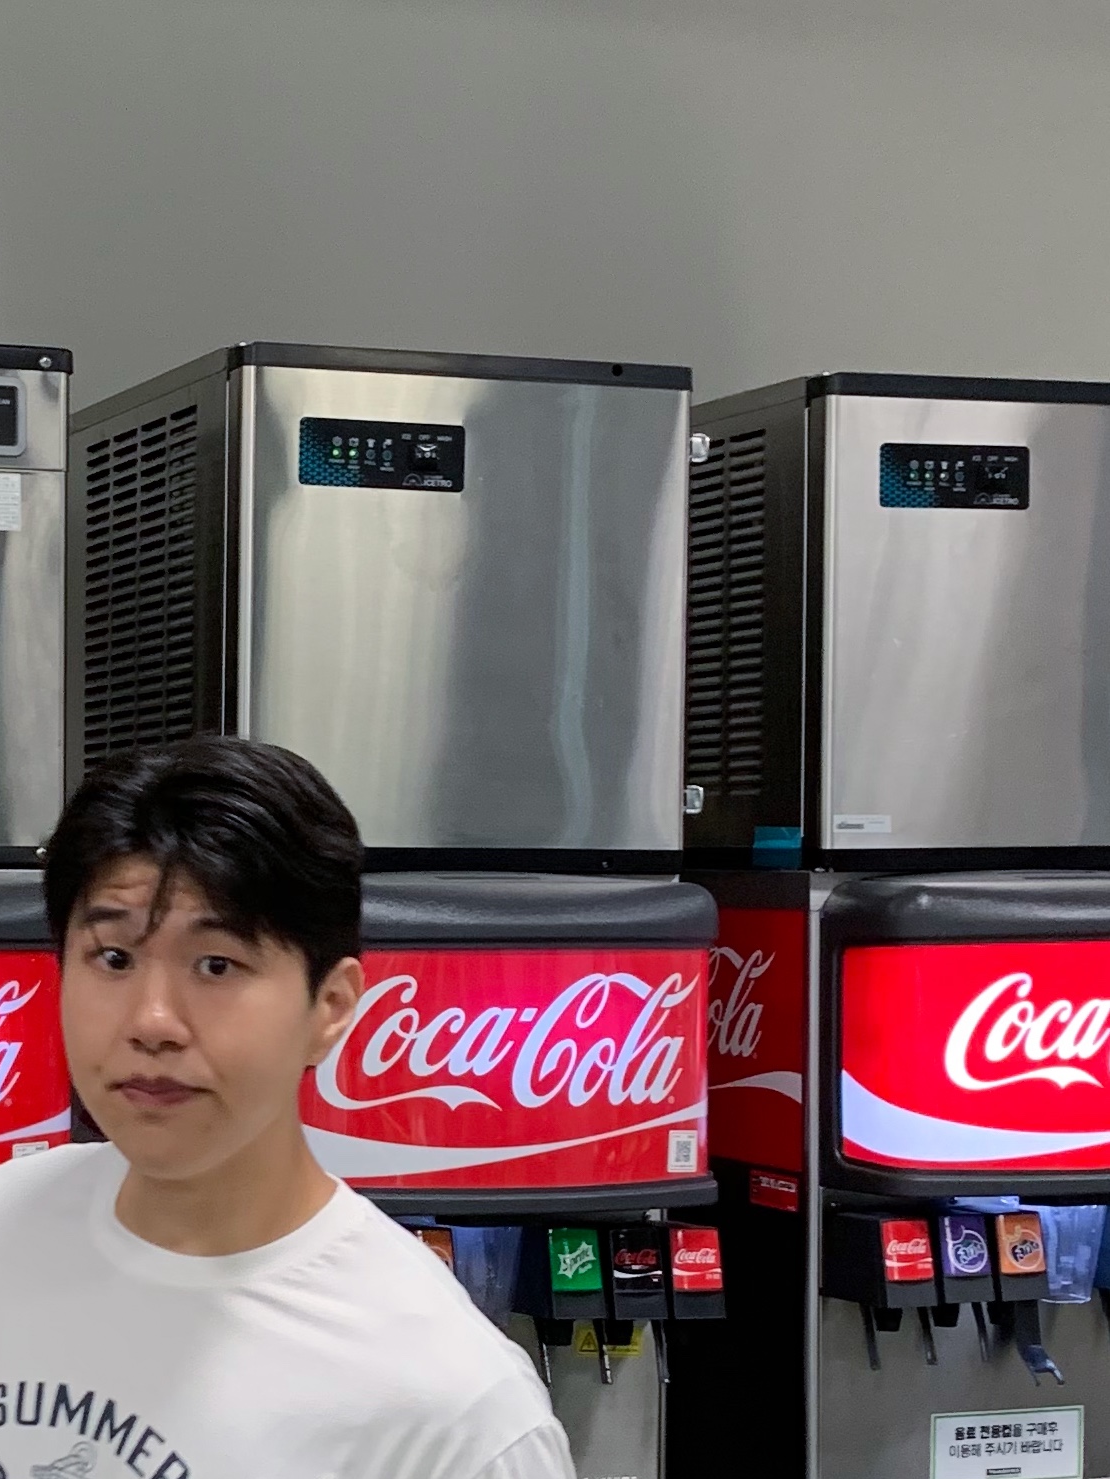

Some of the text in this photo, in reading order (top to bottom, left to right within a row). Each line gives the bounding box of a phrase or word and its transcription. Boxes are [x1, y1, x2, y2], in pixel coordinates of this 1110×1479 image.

[422, 479, 453, 488] ICETRO
[316, 972, 700, 1112] Coca-Cola
[561, 1246, 592, 1272] Sprite
[1010, 1239, 1040, 1263] Fanta
[955, 1421, 1059, 1441] 음료 전용컵을 구매후
[985, 1440, 1018, 1456] 주시기
[1021, 1438, 1064, 1454] 바랍니다
